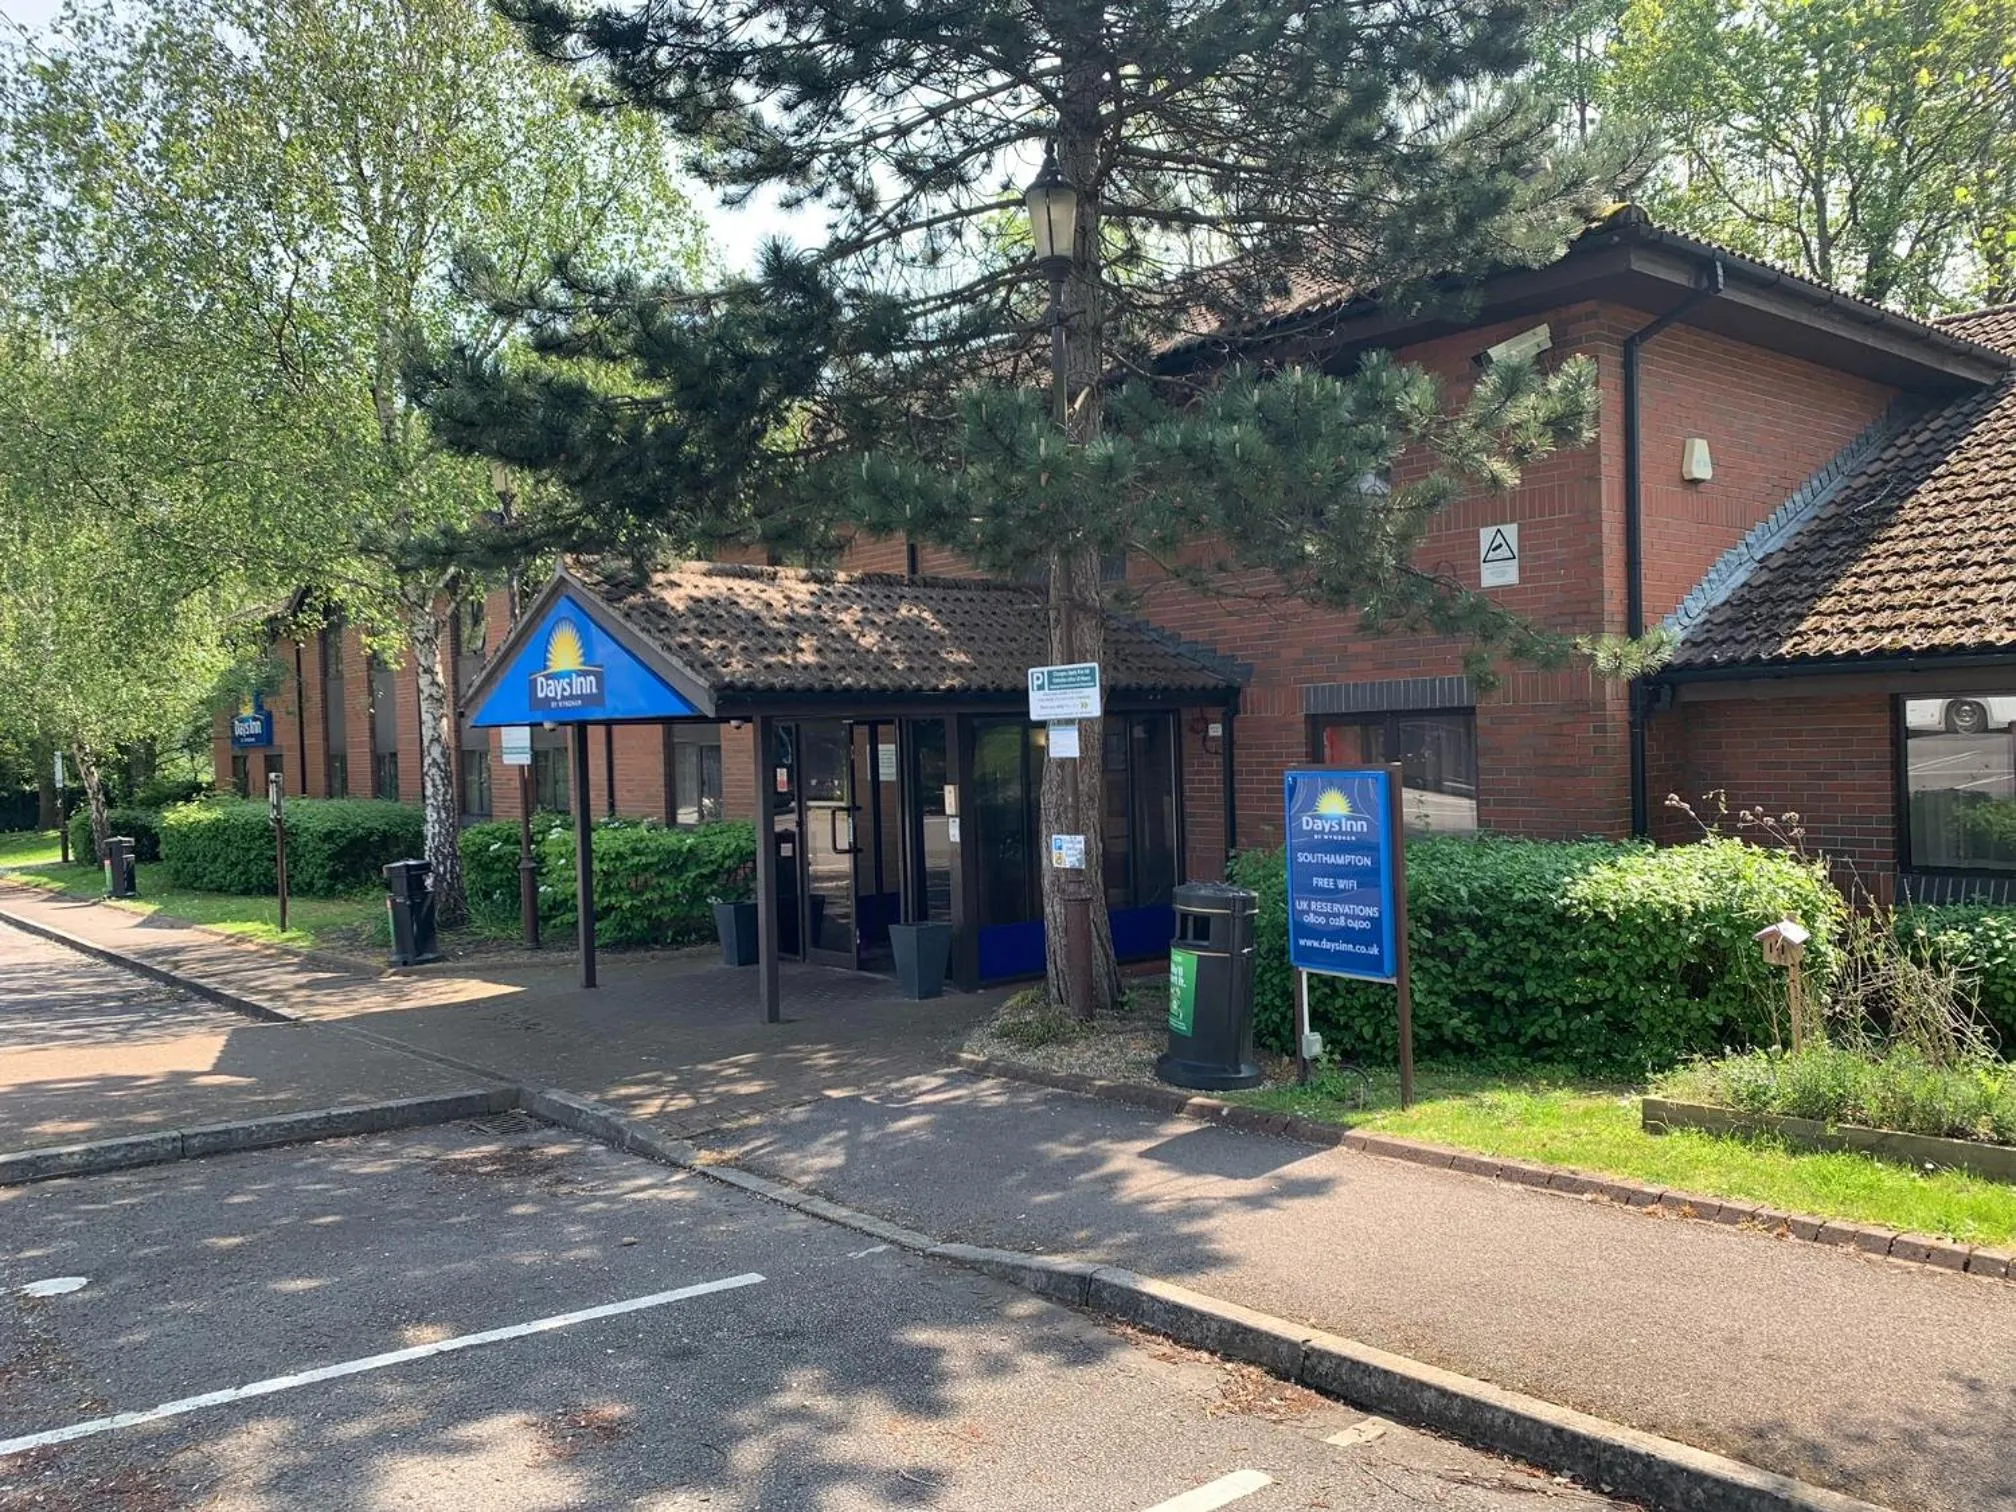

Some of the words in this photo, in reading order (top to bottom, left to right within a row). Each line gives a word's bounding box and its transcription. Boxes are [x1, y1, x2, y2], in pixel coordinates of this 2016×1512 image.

[536, 676, 571, 700] Days
[571, 673, 597, 695] Inn
[1033, 672, 1044, 691] P
[234, 720, 250, 737] Days
[1301, 816, 1340, 833] Days
[1341, 818, 1368, 833] Inn
[1296, 852, 1372, 867] SOUTHAMPTON
[1312, 876, 1336, 889] FREE
[1336, 879, 1358, 890] WIFI
[1296, 900, 1309, 911] UK
[1311, 901, 1380, 918] RESERVATIONS
[1303, 913, 1326, 925] 0800
[1328, 916, 1346, 926] 028
[1347, 920, 1372, 931] 0400
[1298, 938, 1380, 956] www.daysinn.co.uk
